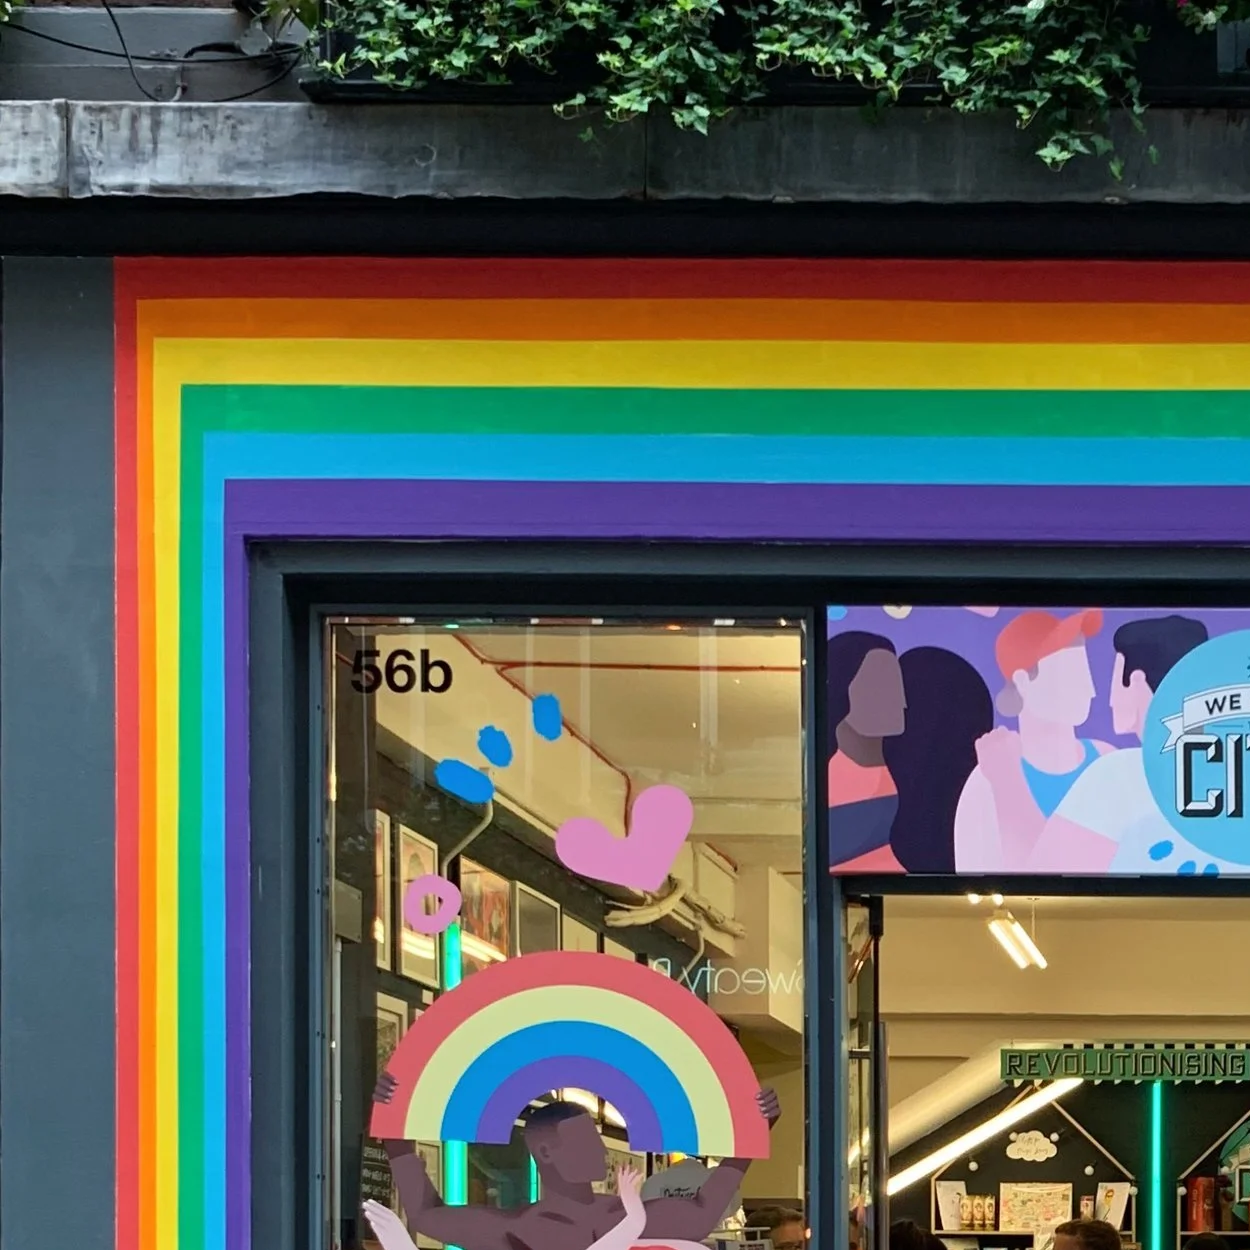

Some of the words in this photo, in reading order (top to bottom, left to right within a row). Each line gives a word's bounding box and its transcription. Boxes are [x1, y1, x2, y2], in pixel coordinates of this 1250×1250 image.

[351, 649, 453, 693] 56b
[1205, 693, 1242, 715] WE
[1005, 1051, 1246, 1077] REVOLUTIONISING
